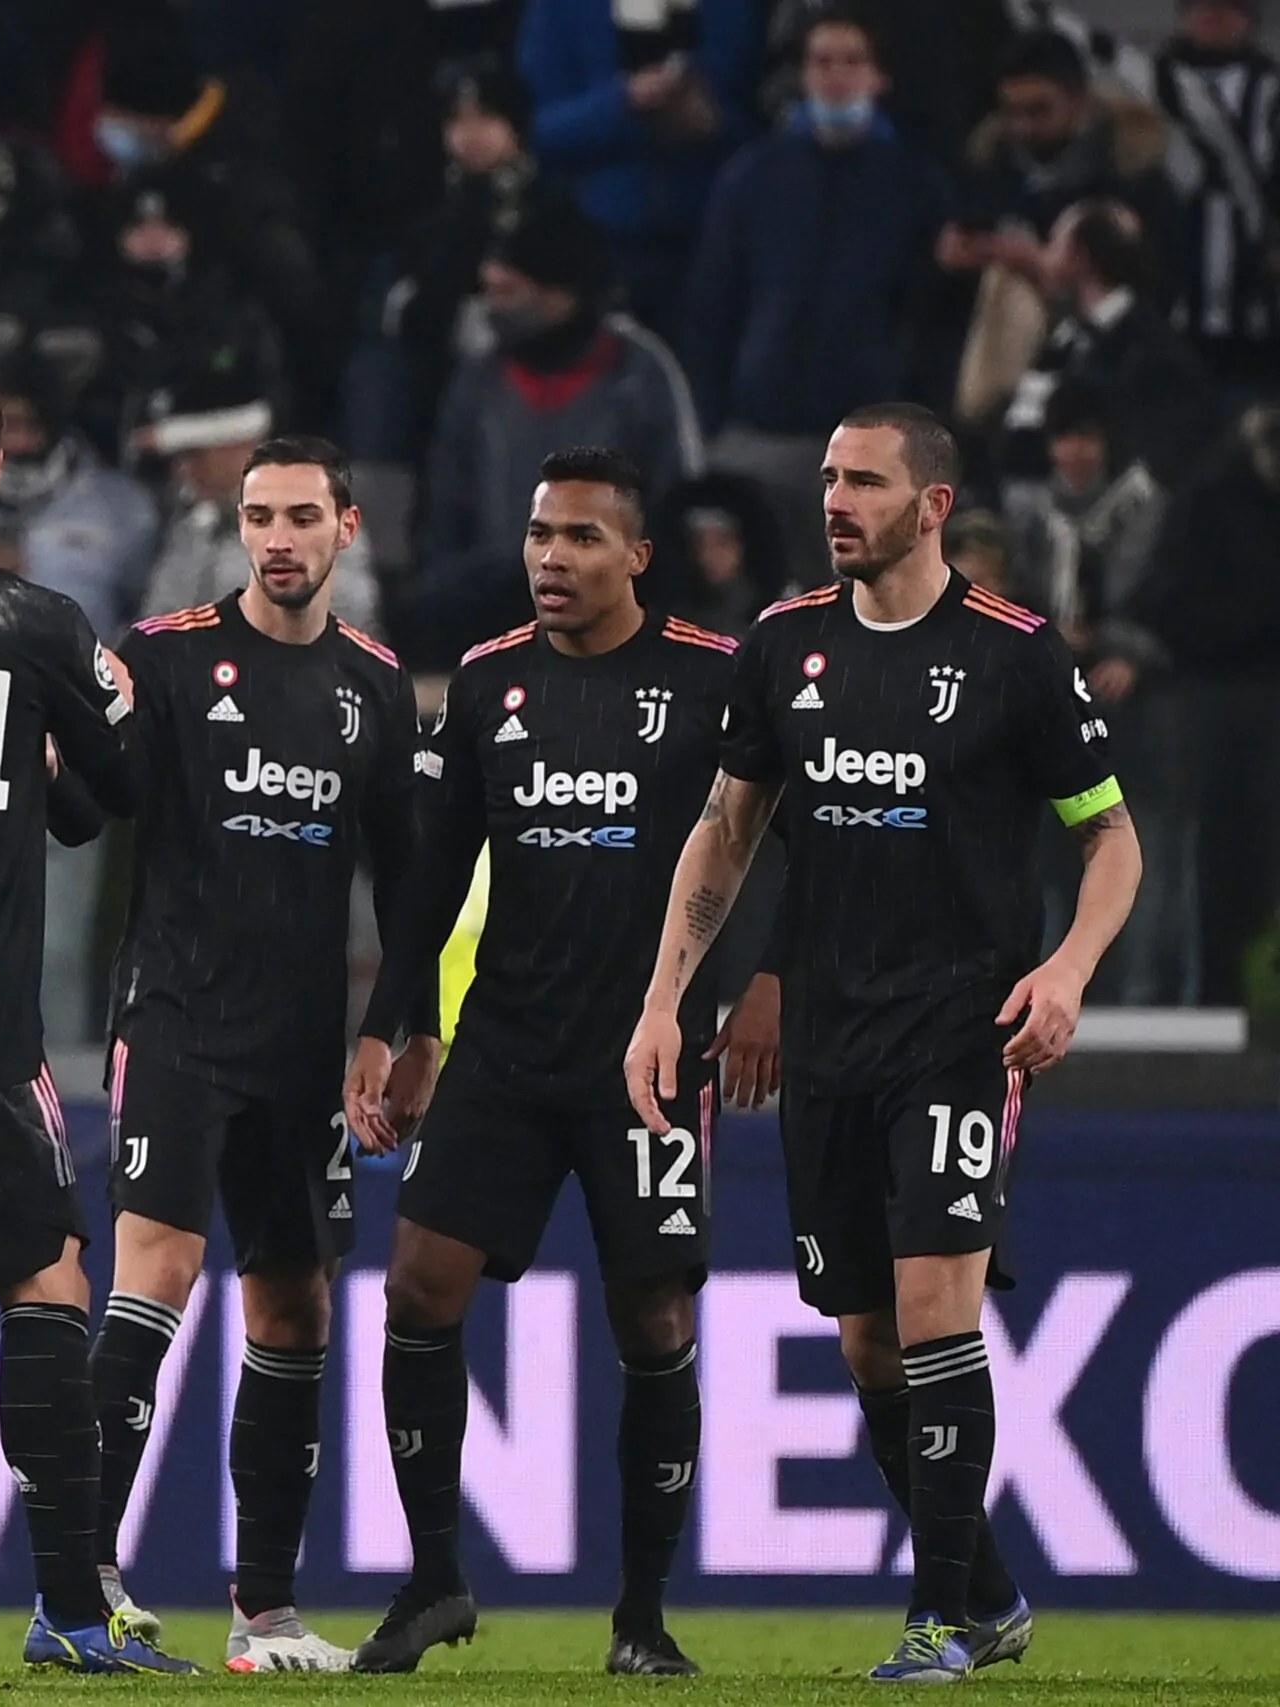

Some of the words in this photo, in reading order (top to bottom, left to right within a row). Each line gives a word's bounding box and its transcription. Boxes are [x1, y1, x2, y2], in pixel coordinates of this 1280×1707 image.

[224, 748, 342, 811] Jeep
[513, 761, 638, 814] Jeep
[804, 737, 927, 795] Jeep
[627, 1127, 696, 1198] 12
[928, 1104, 994, 1179] 19
